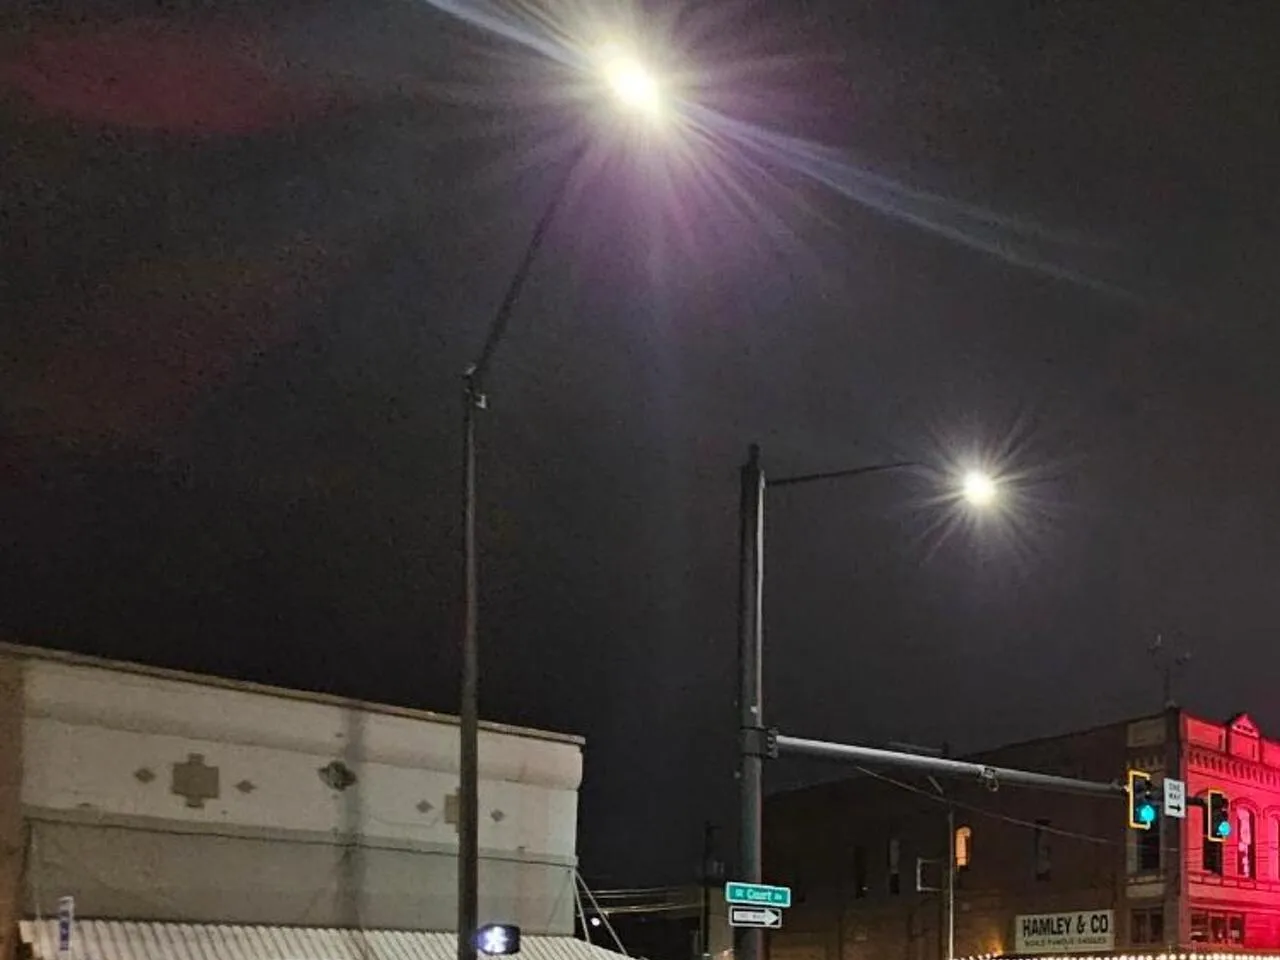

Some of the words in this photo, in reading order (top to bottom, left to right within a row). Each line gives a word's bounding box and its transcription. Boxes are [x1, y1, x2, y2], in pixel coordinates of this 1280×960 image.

[1023, 916, 1073, 937] HAMLEY
[1076, 914, 1086, 934] &
[1090, 914, 1109, 933] CO
